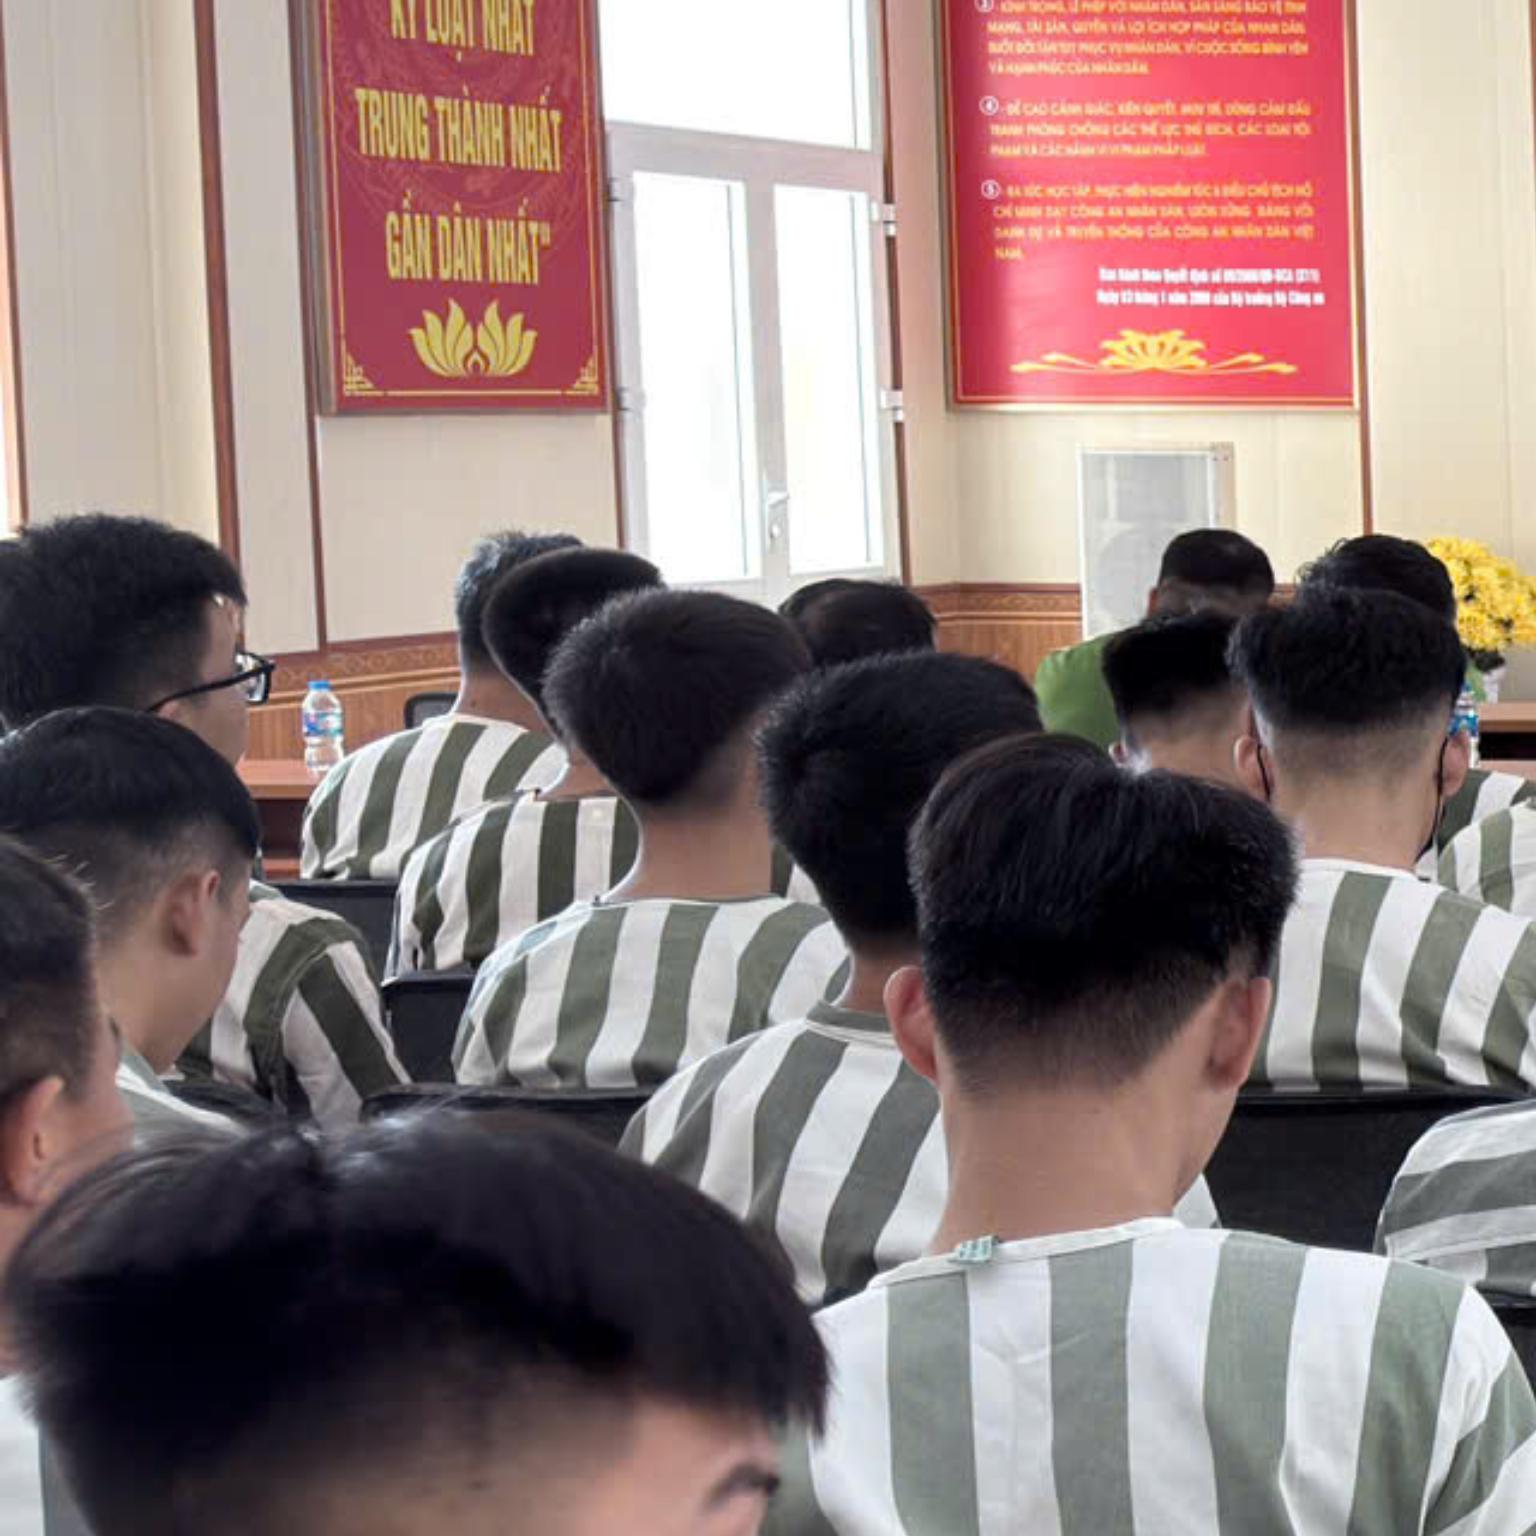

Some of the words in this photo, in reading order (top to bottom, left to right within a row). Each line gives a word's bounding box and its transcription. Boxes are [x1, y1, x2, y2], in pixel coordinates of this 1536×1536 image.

[355, 88, 430, 160] TRUNG
[434, 84, 504, 166] THÀNH
[510, 85, 561, 173] NHẤT
[385, 189, 432, 279] GẦN
[437, 201, 482, 282] DÂN
